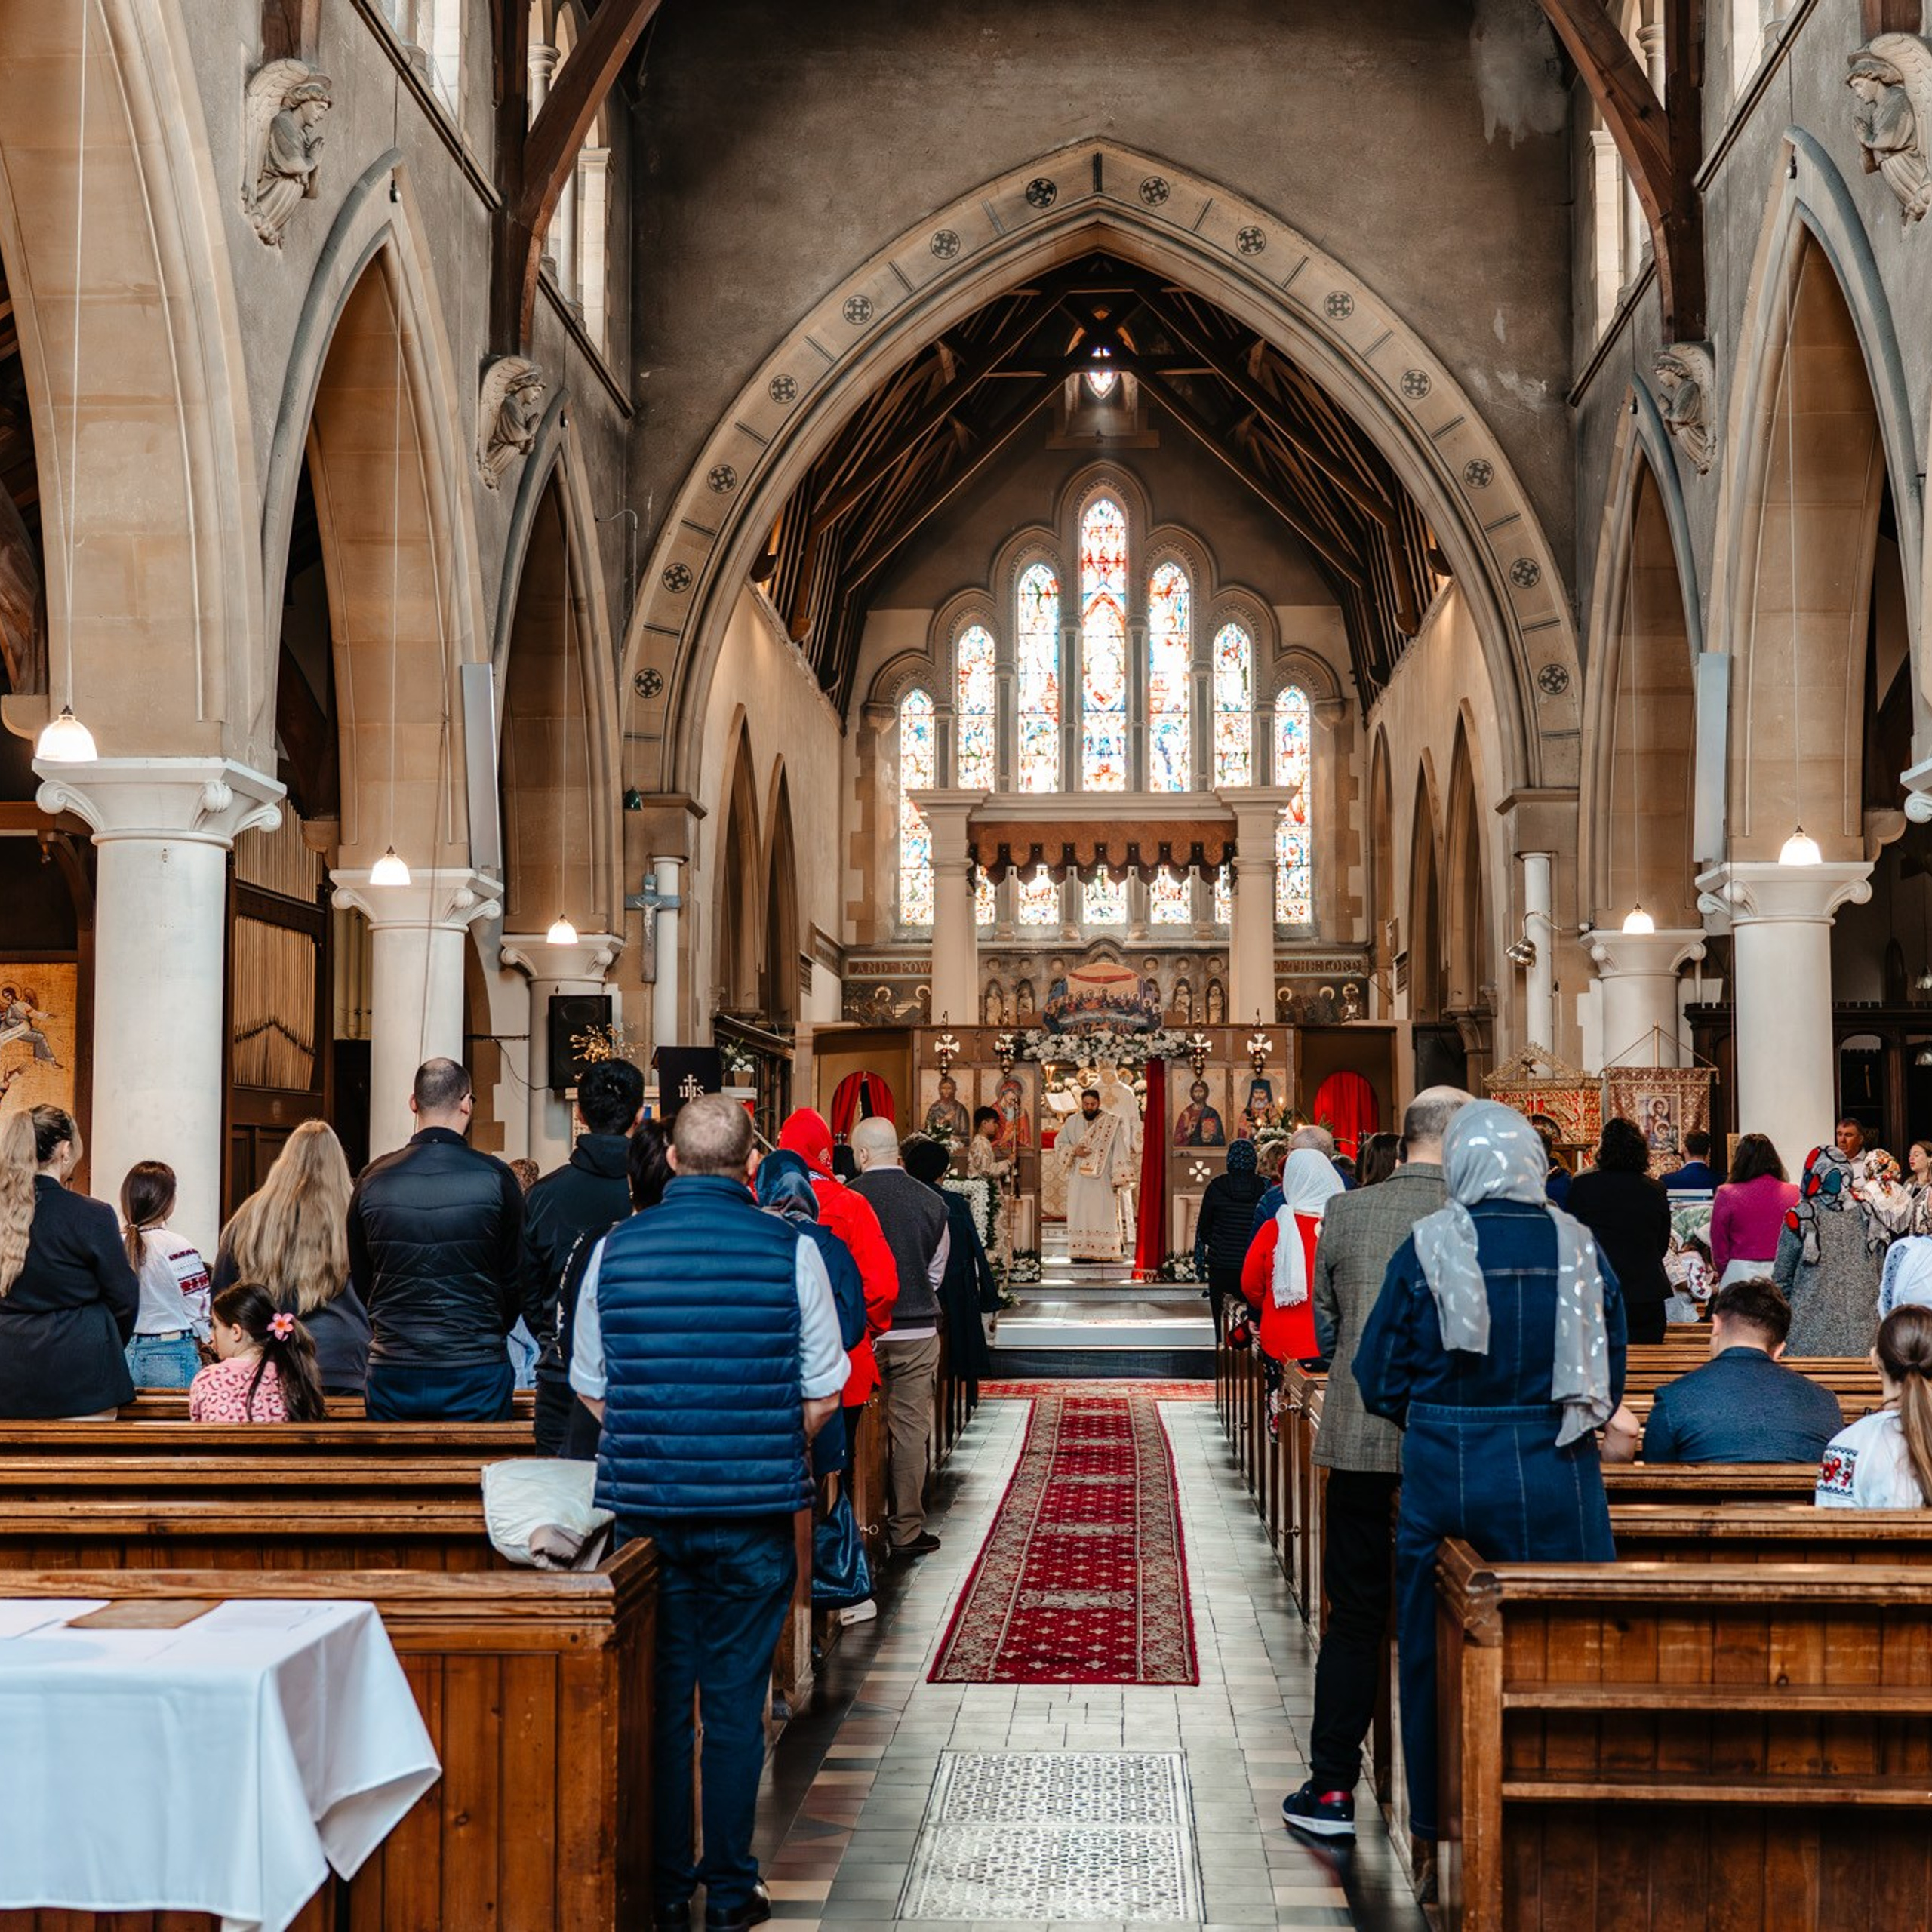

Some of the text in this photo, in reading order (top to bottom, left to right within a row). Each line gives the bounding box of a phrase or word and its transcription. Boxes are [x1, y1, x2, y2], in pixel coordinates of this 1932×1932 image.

[855, 961, 931, 974] AND POW
[678, 1085, 705, 1098] IHS
